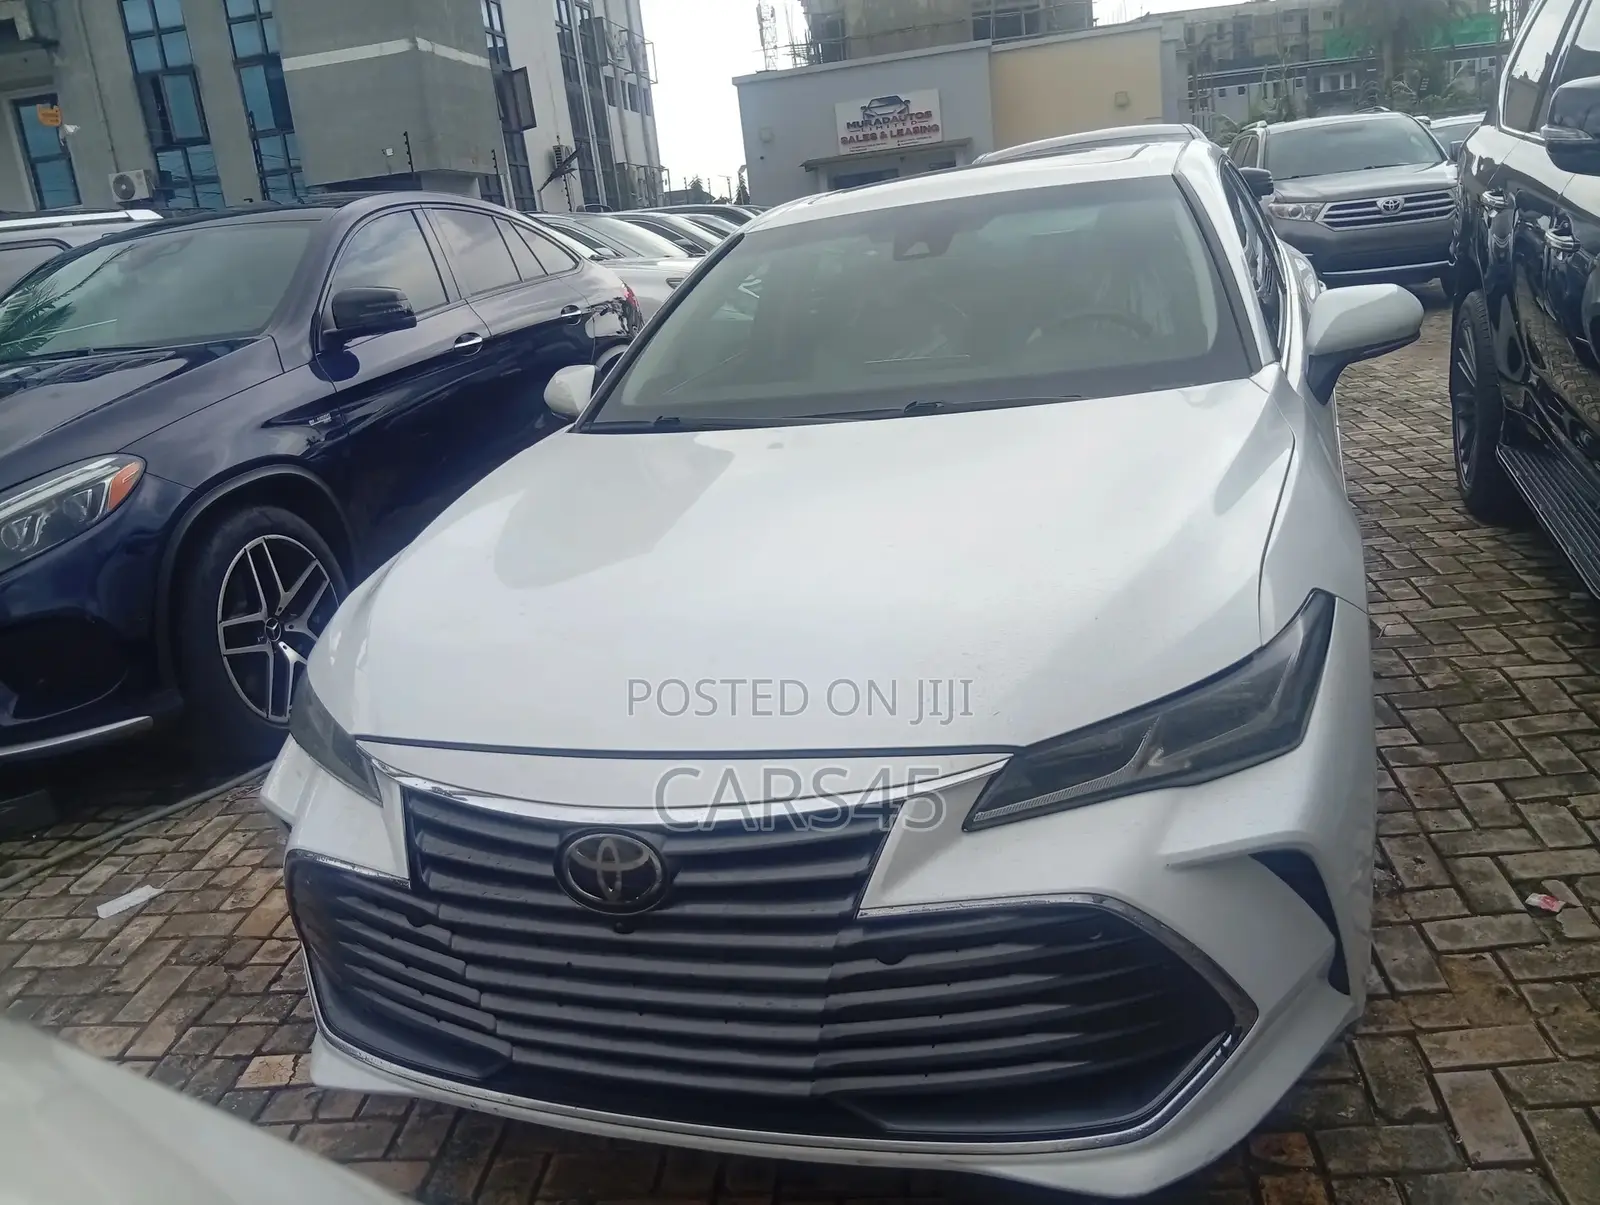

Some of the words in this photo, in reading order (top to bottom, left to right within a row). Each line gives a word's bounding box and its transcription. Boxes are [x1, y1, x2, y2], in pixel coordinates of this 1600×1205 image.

[840, 132, 878, 145] SALES
[879, 130, 888, 139] &
[889, 123, 940, 138] LEASING
